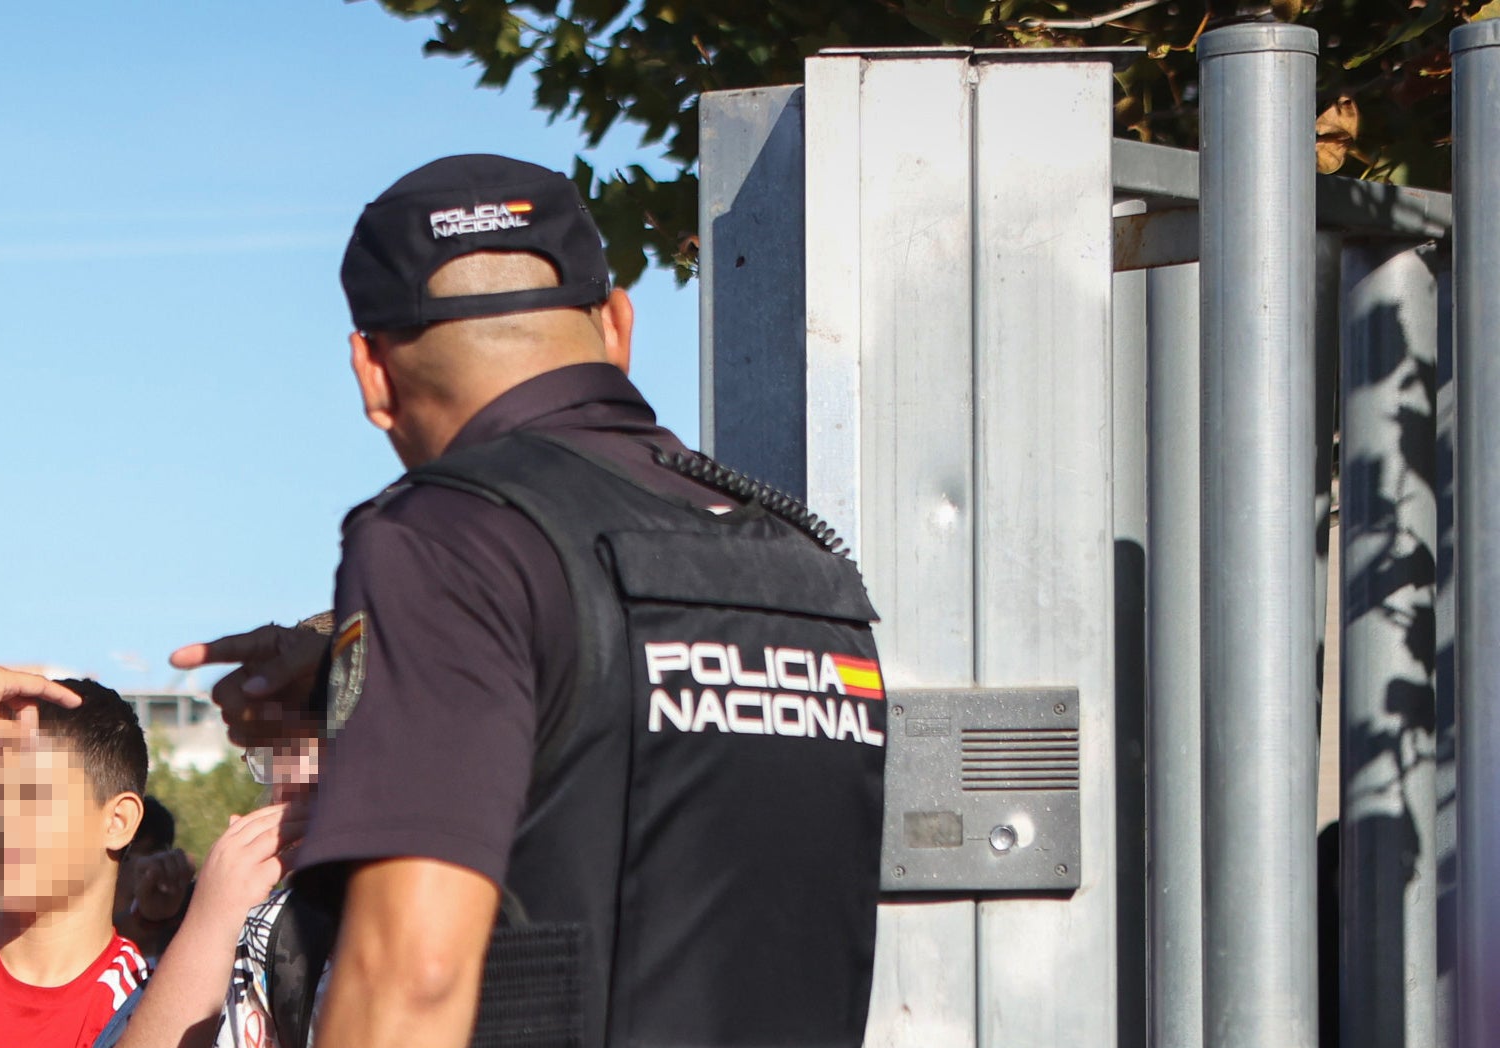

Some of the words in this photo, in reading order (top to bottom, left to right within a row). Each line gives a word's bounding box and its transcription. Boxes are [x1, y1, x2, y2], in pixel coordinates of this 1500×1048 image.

[430, 203, 510, 227] POLICIA
[431, 215, 531, 240] NACIONAL
[644, 641, 847, 695] POLICIA
[648, 688, 884, 747] NACIONAL
